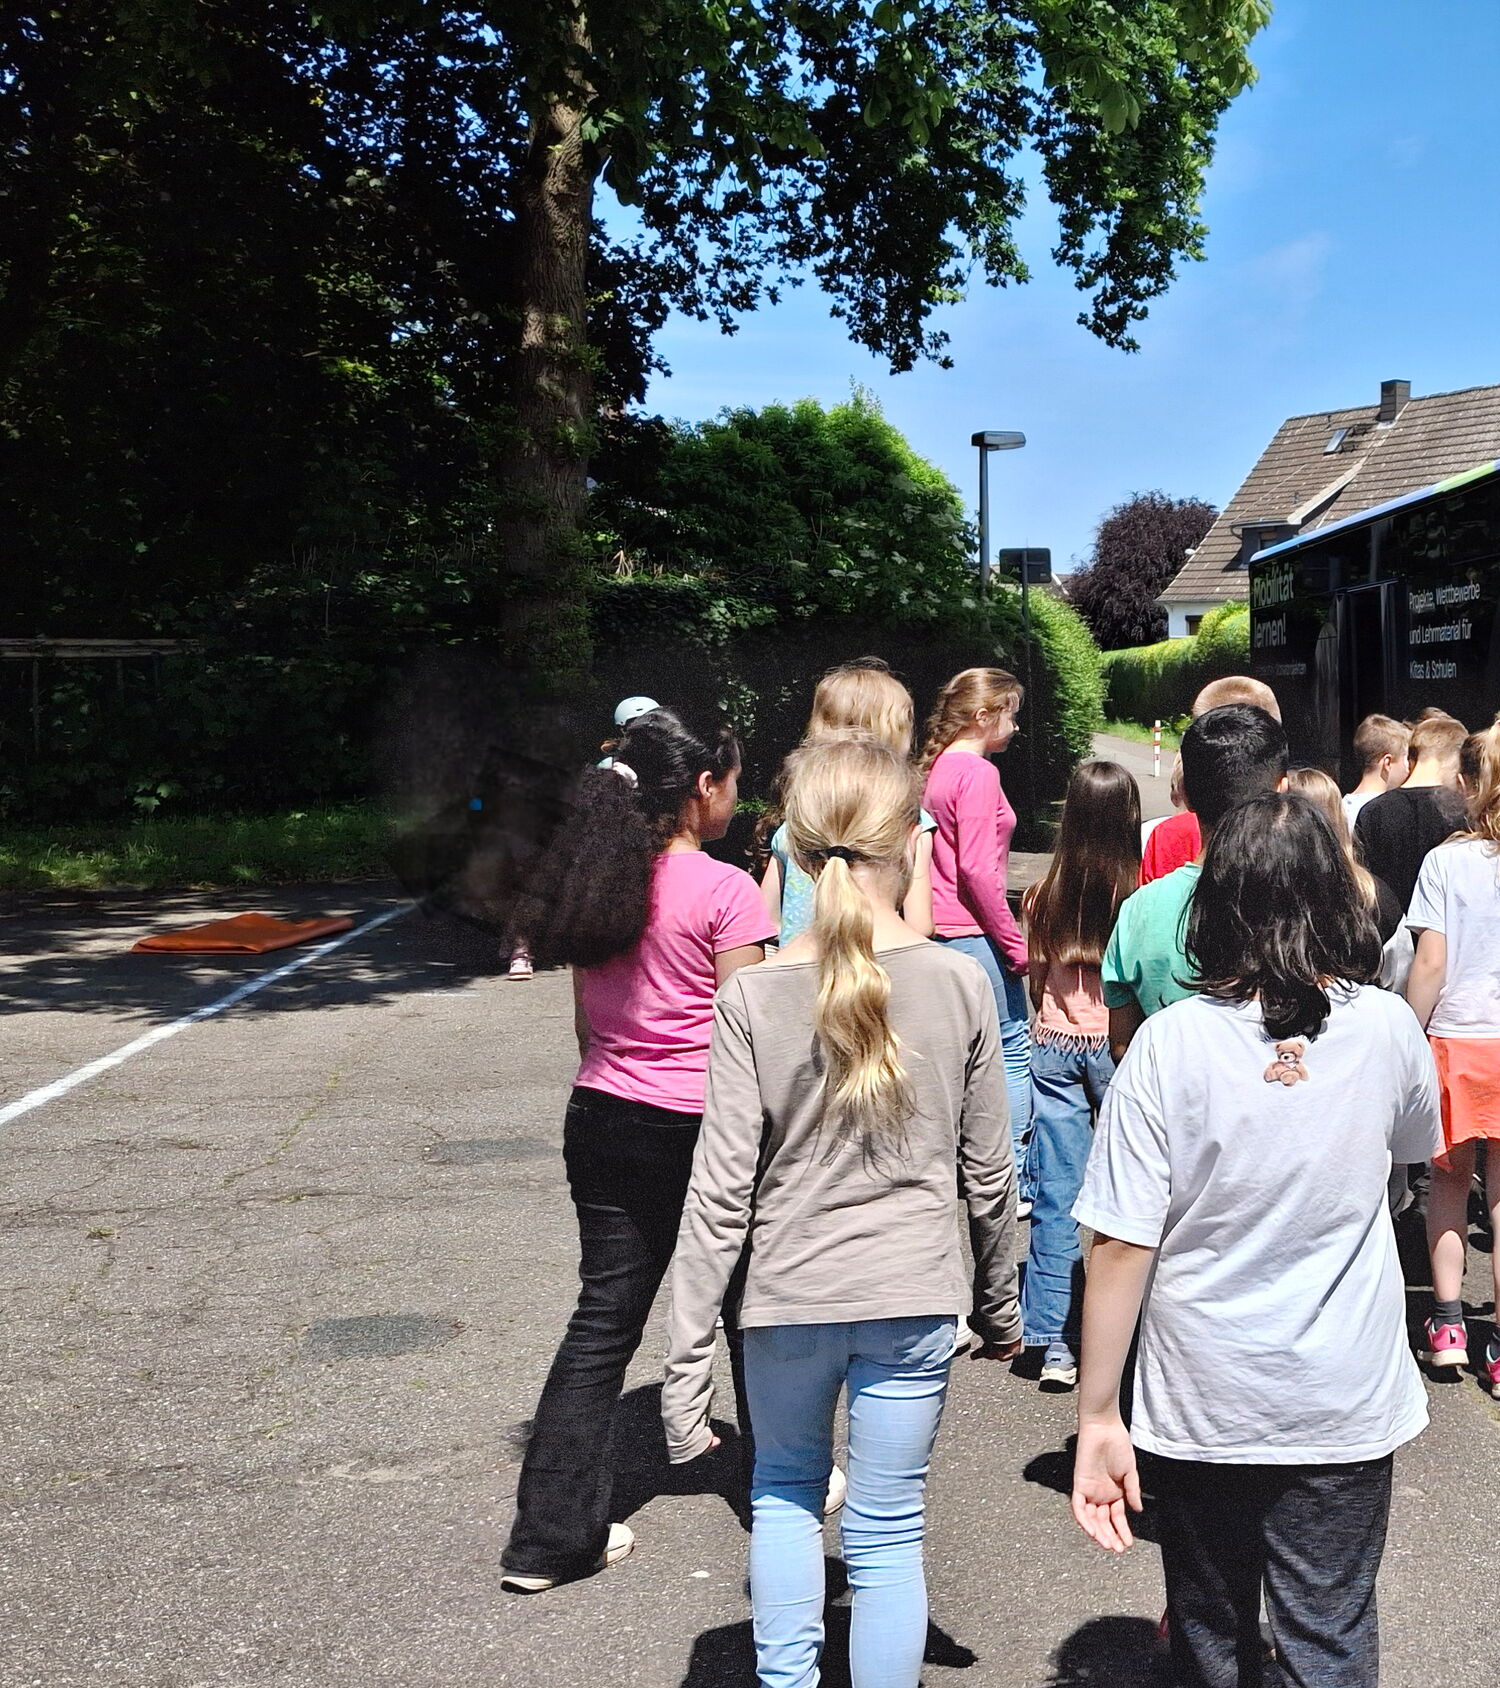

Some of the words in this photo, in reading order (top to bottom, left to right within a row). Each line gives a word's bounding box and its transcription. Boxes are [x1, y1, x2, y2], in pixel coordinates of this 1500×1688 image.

[1253, 564, 1294, 607] Mobilität
[1409, 588, 1435, 614] Projekte,
[1436, 579, 1481, 606] Wettbewerbe
[1253, 612, 1287, 649] lernen!
[1409, 625, 1421, 645] und
[1421, 620, 1461, 644] Lehrmaterial
[1461, 618, 1472, 640] für
[1409, 660, 1424, 679] Kitas
[1431, 659, 1457, 679] Schulen
